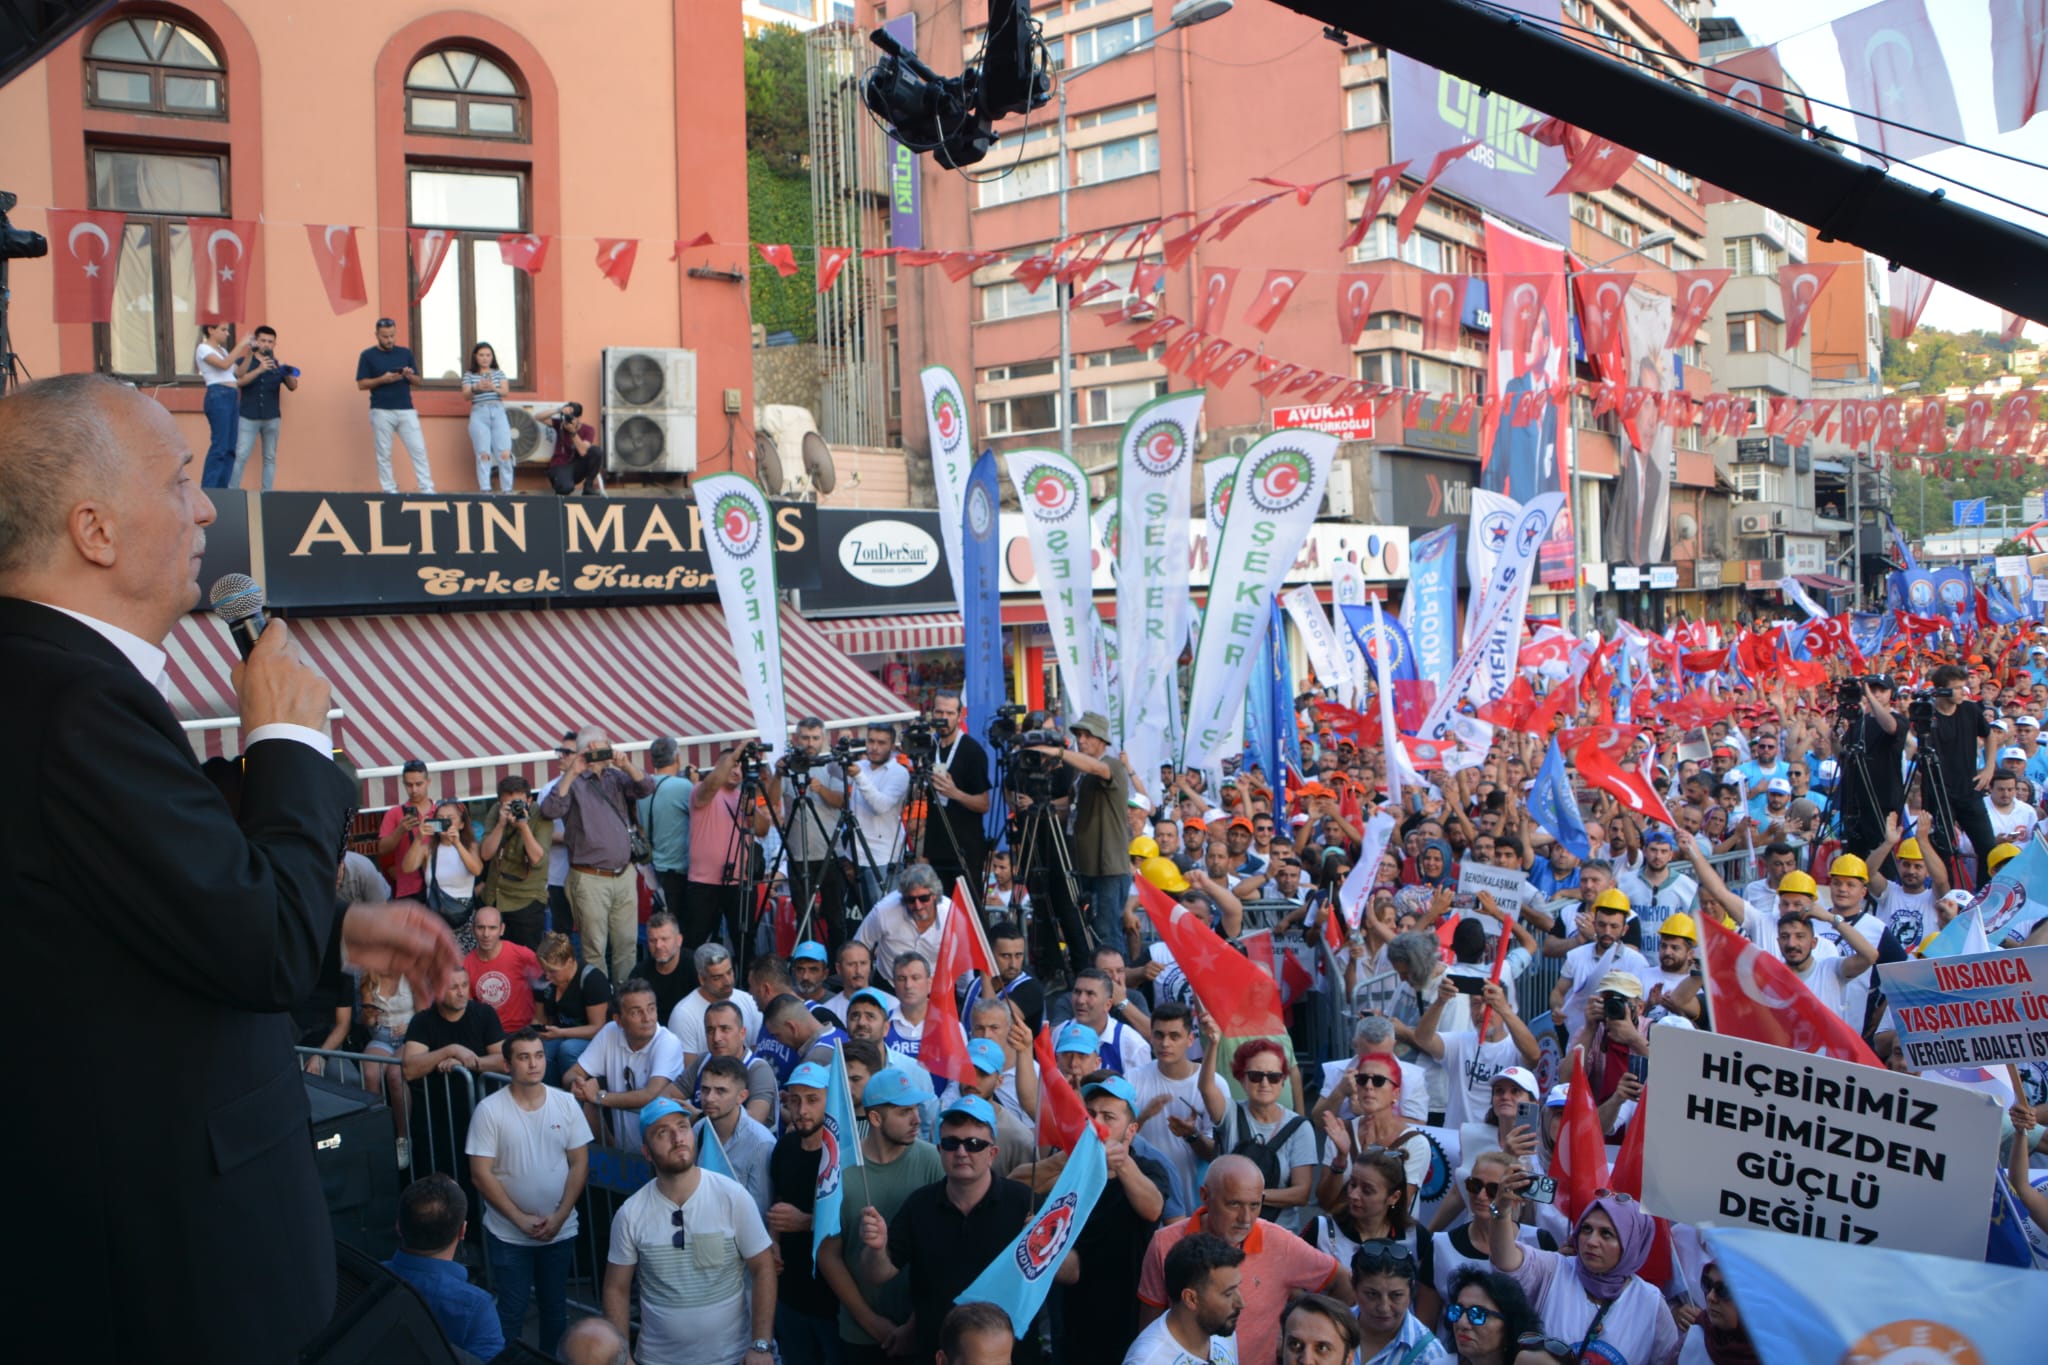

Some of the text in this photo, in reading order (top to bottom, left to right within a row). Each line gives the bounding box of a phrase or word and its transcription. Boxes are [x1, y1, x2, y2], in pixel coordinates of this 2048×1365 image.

[289, 498, 527, 556] ALTIN
[564, 503, 805, 553] MAS
[417, 566, 560, 596] Erkek
[1144, 493, 1167, 640] ŞEKER
[1224, 521, 1276, 667] ŞEKER
[1933, 958, 2032, 992] İNSANCA
[1898, 997, 2021, 1033] YAŞAYACAK
[1906, 1036, 1970, 1066] VERGİDE
[1971, 1033, 2026, 1061] ADALET
[1702, 1051, 1938, 1131] HİÇBİRİMİZ
[1687, 1094, 1946, 1181] HEPİMİZDEN
[1737, 1150, 1880, 1209] GÜÇLÜ
[1719, 1189, 1879, 1245] DEĞİLİZ
